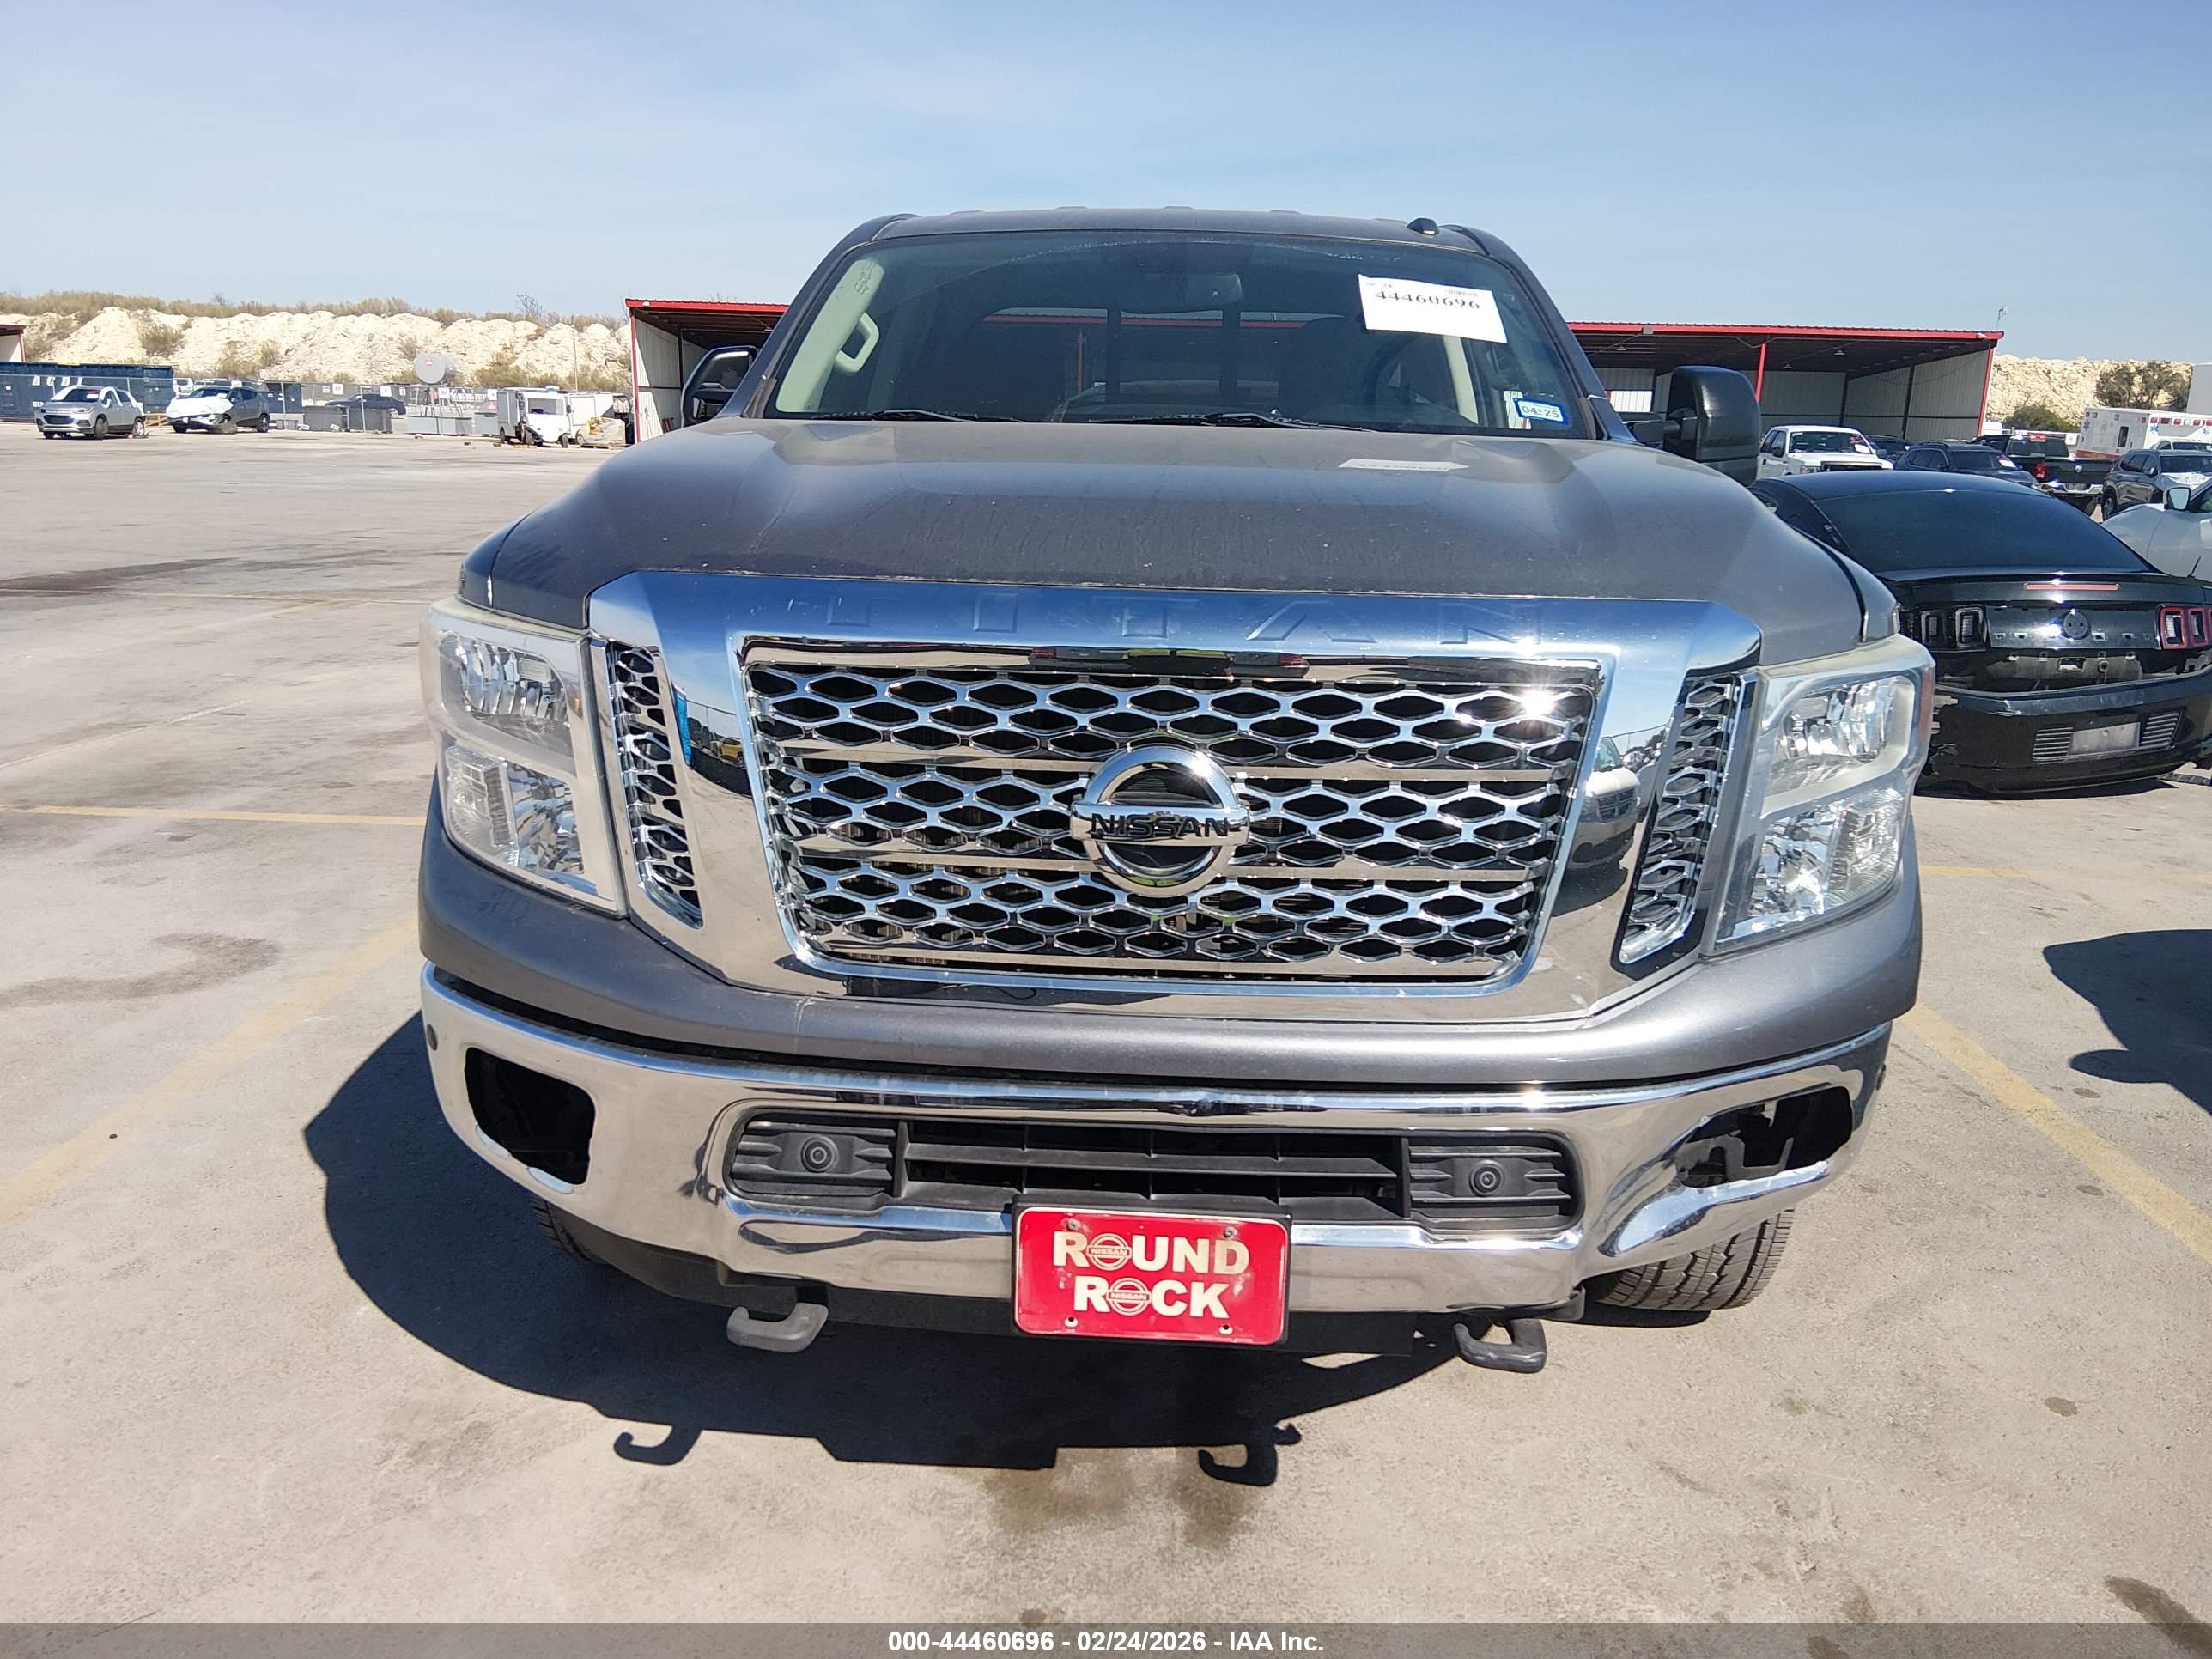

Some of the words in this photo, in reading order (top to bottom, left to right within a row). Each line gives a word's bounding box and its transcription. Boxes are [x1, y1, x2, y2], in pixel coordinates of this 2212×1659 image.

[1374, 290, 1480, 309] 44460696
[1091, 813, 1229, 838] NISSAN
[1053, 1231, 1250, 1275] ROUND
[1091, 1247, 1128, 1256] NISSAN
[1074, 1276, 1230, 1319] ROCK
[1110, 1291, 1147, 1302] NISSAN
